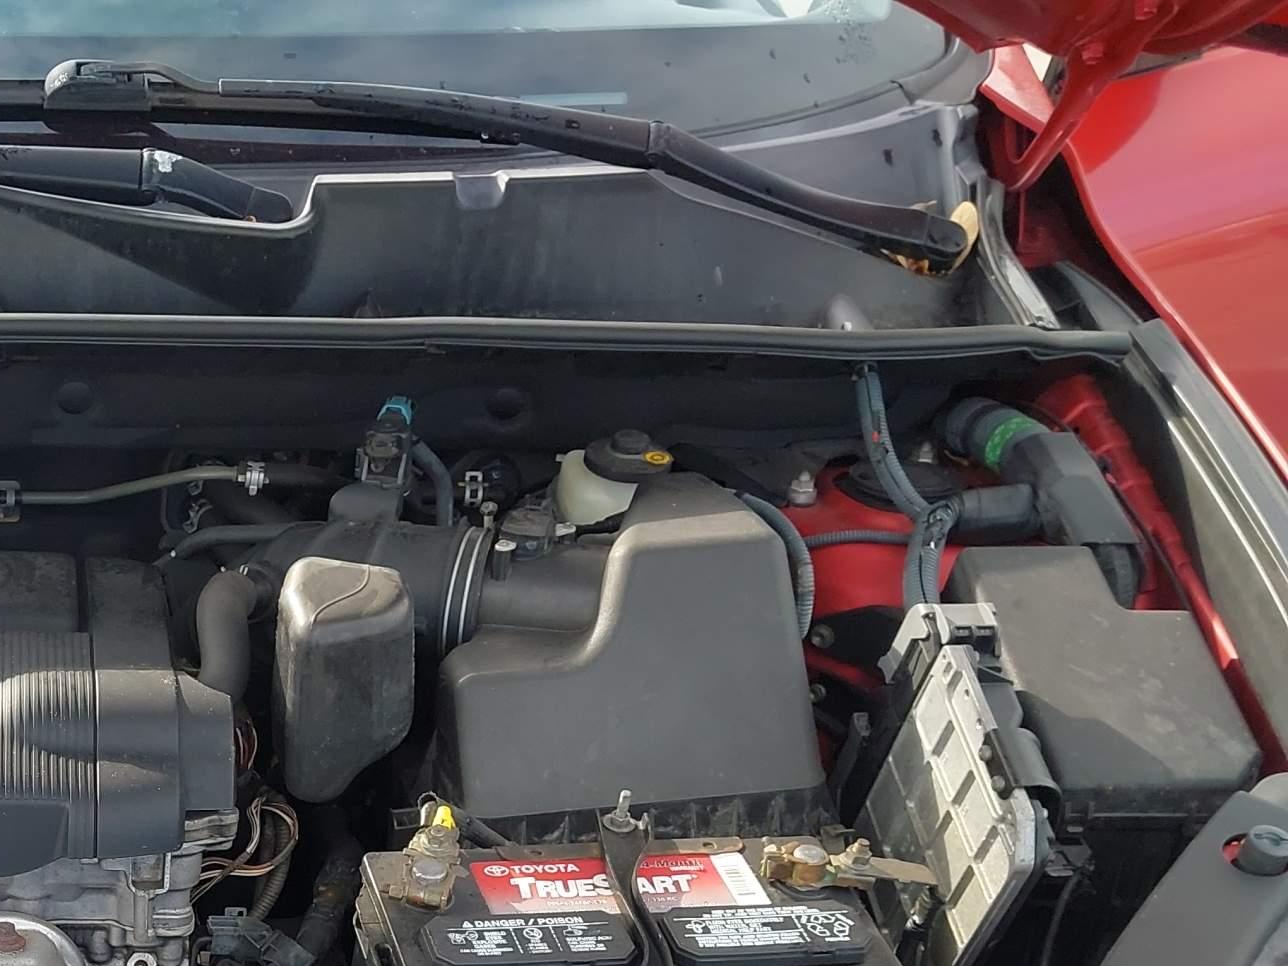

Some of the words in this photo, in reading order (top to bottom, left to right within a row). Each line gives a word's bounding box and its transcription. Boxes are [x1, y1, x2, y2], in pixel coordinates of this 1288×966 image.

[510, 863, 580, 874] TOYOTA
[474, 919, 526, 928] DANGER
[537, 916, 584, 925] POISON
